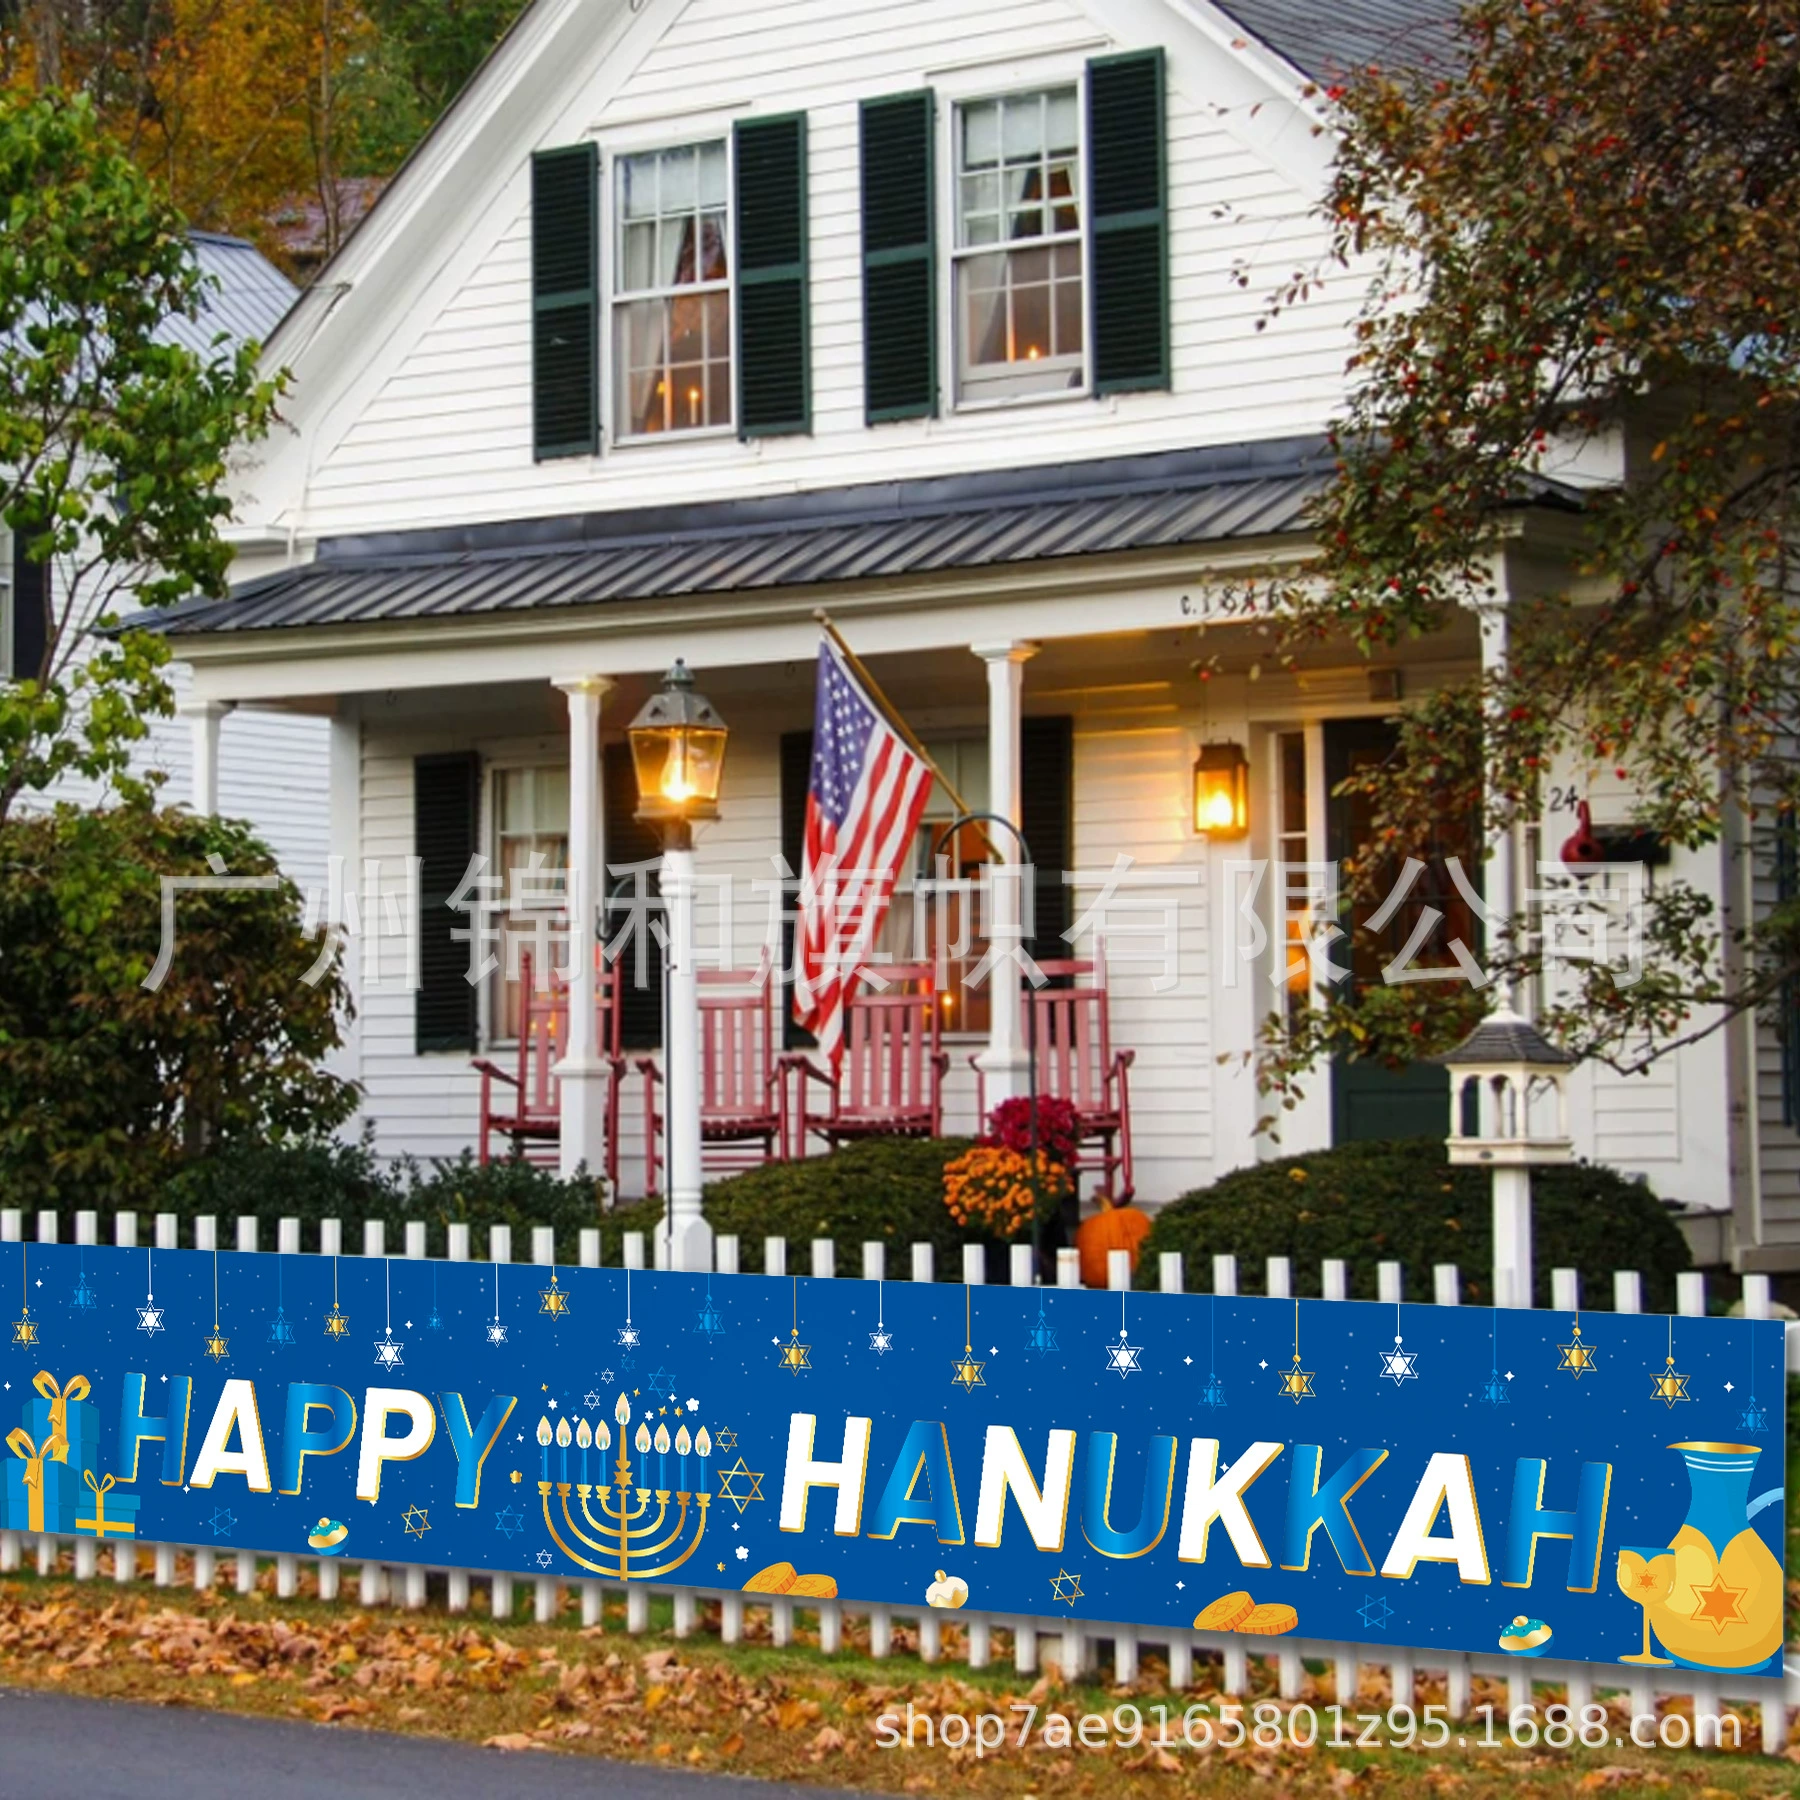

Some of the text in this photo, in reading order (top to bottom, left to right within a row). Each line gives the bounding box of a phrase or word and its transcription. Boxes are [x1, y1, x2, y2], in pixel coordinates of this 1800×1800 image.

[1550, 785, 1578, 811] 24
[115, 1372, 1613, 1593] HAPPY HANUKKAH
